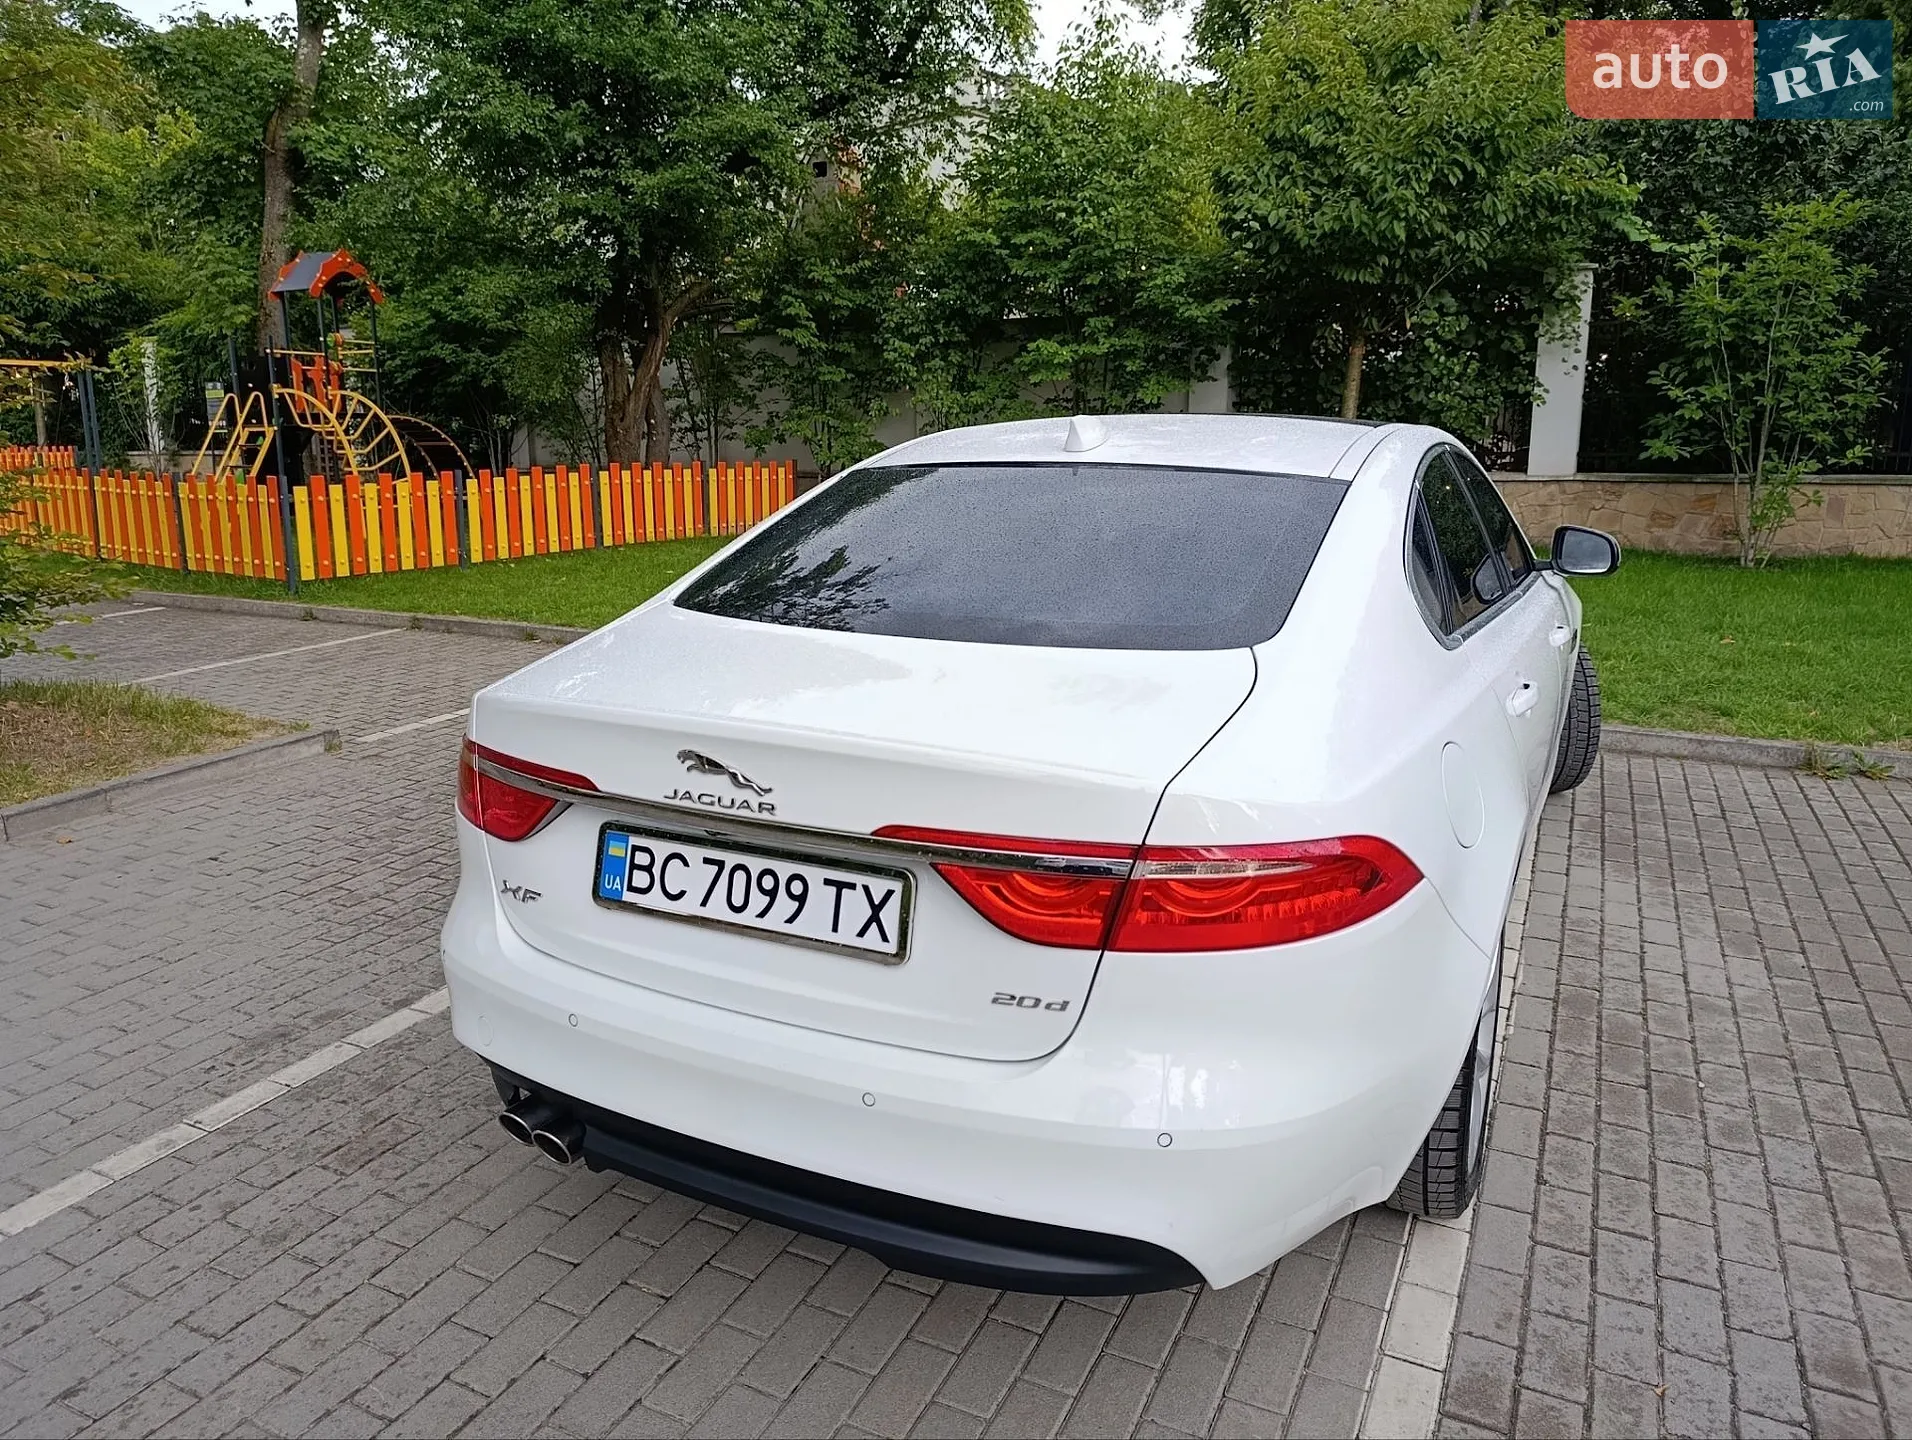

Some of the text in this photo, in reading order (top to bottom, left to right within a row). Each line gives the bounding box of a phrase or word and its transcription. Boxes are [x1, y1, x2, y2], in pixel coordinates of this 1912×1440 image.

[664, 788, 777, 815] JAGUAR
[501, 879, 542, 904] XF
[604, 874, 622, 892] UA
[626, 844, 895, 943] BC 7099 TX
